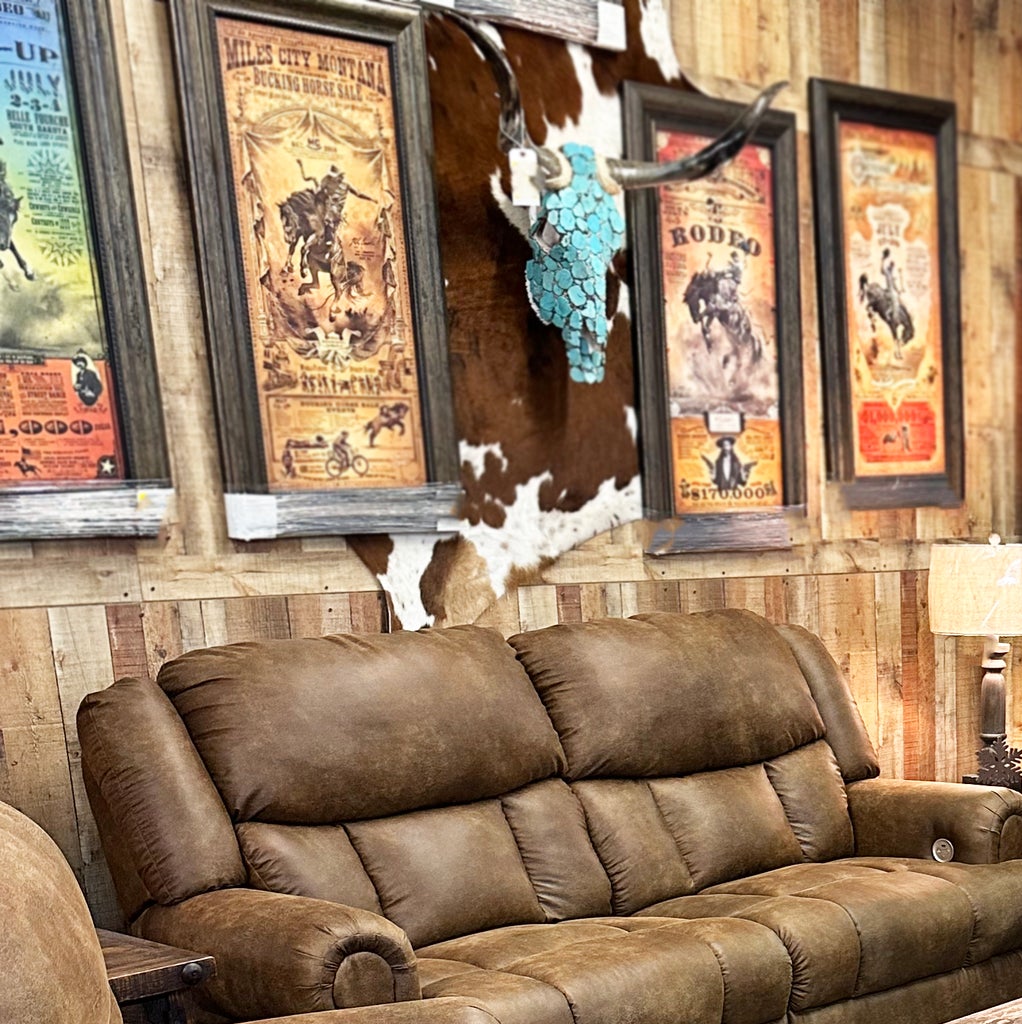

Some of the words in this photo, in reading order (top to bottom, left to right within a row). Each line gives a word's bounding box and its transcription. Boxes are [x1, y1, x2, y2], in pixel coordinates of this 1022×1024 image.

[4, 69, 60, 97] JULY
[223, 37, 273, 71] MILES
[278, 47, 311, 67] CITY
[316, 53, 386, 96] MONTANA
[253, 66, 300, 93] BUCKING
[302, 76, 336, 98] HORSE
[337, 83, 363, 101] SALE
[9, 122, 33, 132] SOUTH
[37, 125, 67, 135] DAKOTA
[669, 224, 762, 257] RODEO
